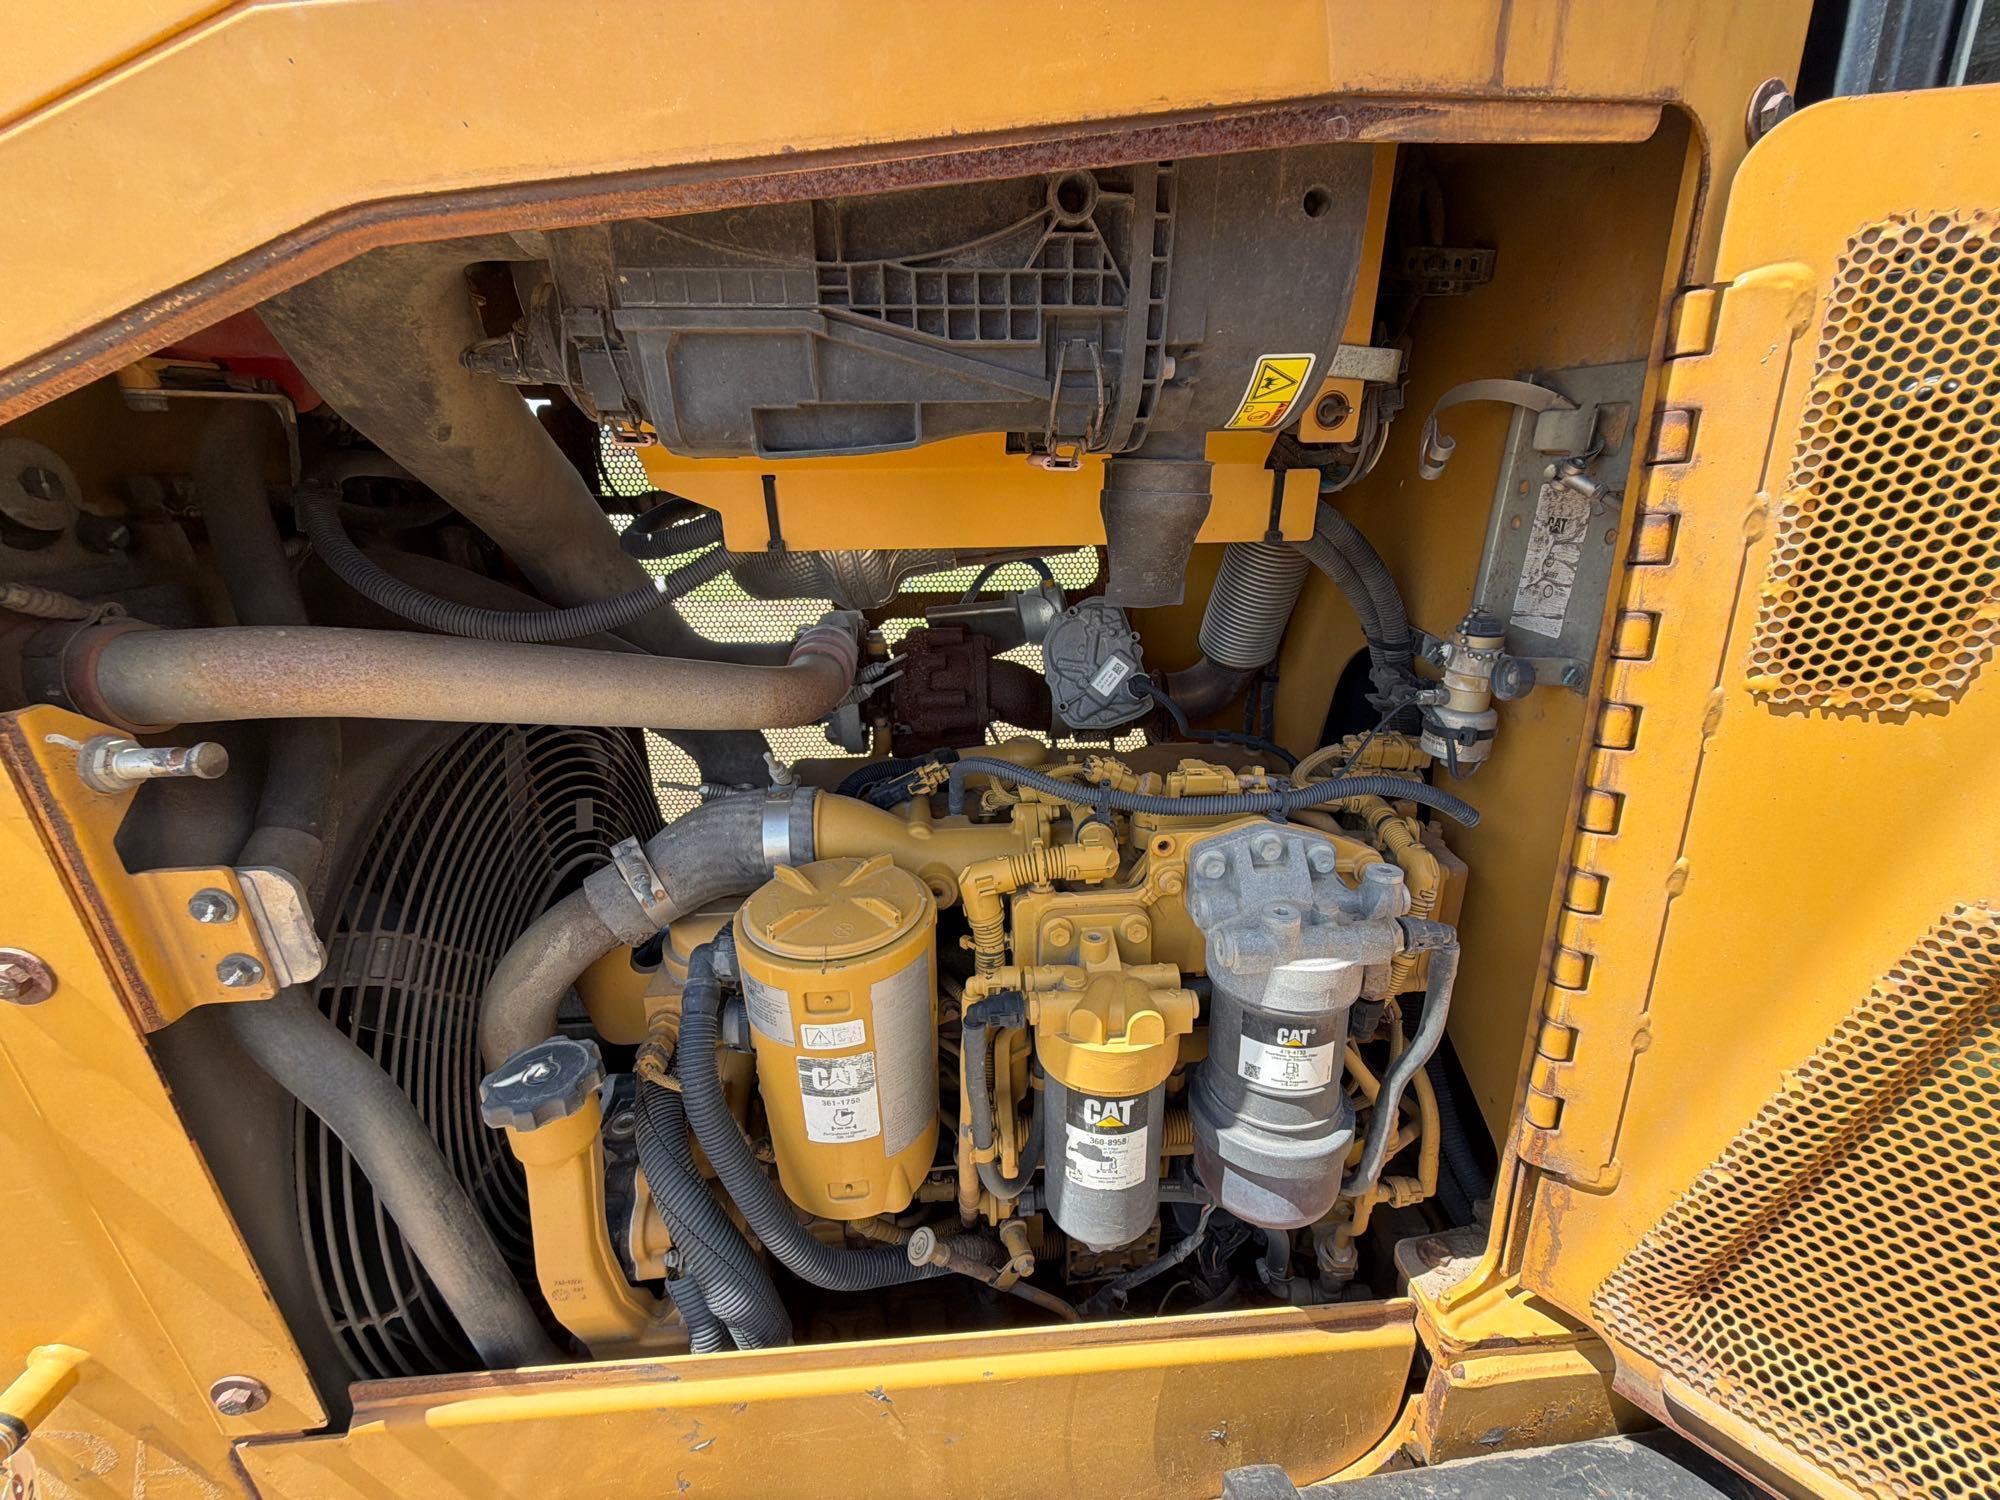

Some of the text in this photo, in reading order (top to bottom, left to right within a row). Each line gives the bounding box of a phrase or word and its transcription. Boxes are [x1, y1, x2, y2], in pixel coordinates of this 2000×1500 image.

[1548, 517, 1568, 534] CAT
[1277, 1028, 1311, 1047] CAT
[812, 1067, 862, 1091] CAT
[1084, 1099, 1135, 1127] CAT
[1090, 1137, 1127, 1146] 360-8958
